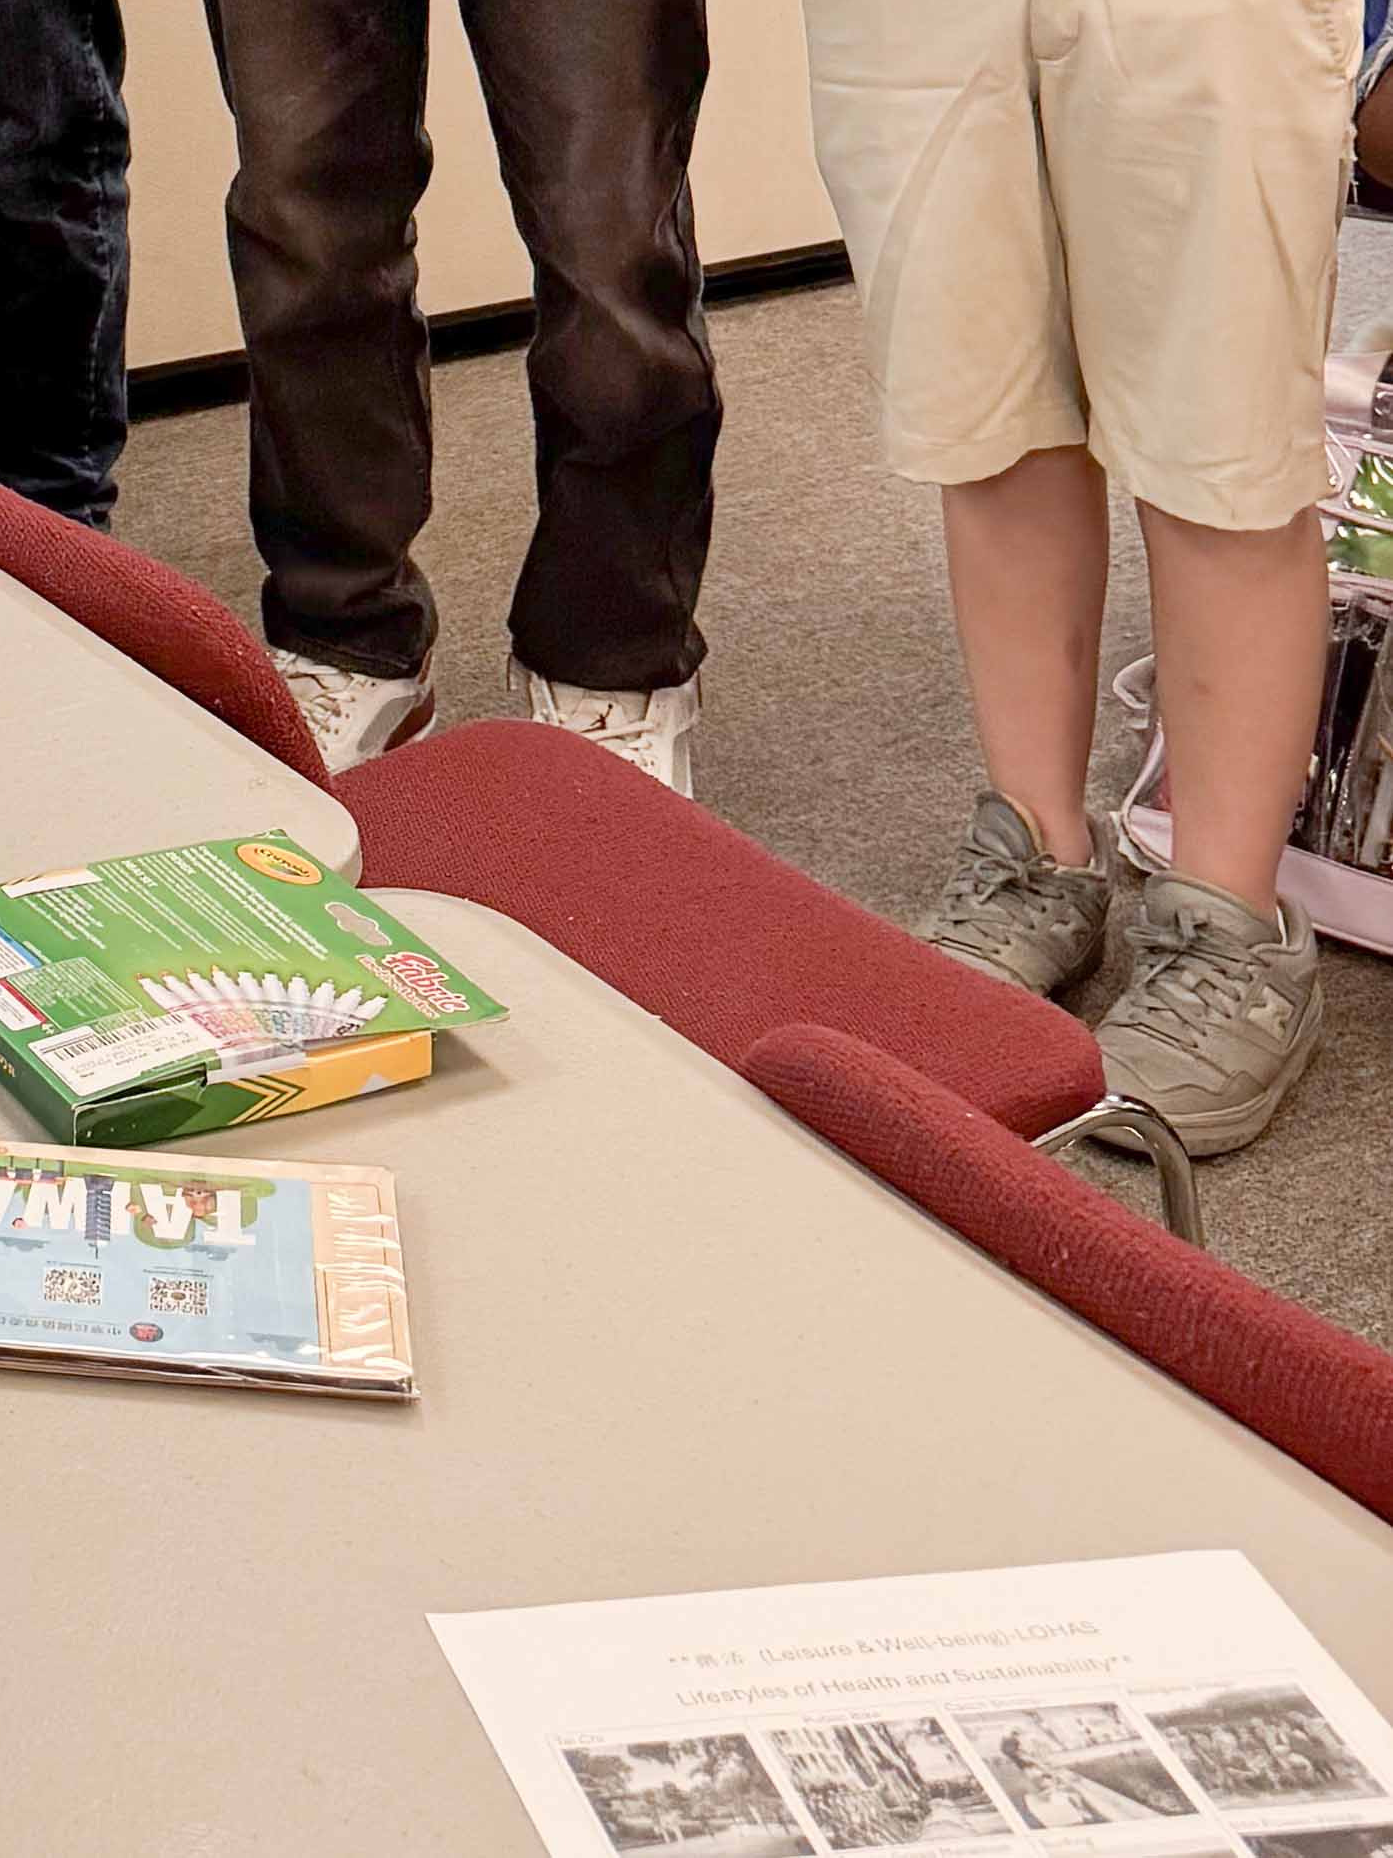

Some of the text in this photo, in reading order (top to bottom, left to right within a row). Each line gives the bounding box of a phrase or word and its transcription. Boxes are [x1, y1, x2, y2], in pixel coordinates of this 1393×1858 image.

[383, 951, 471, 1014] Fabric
[759, 1639, 852, 1665] (Leisure
[856, 1637, 875, 1655] &
[675, 1678, 790, 1708] Lifestyles
[793, 1680, 816, 1700] of
[820, 1672, 902, 1697] Health
[907, 1666, 952, 1689] and
